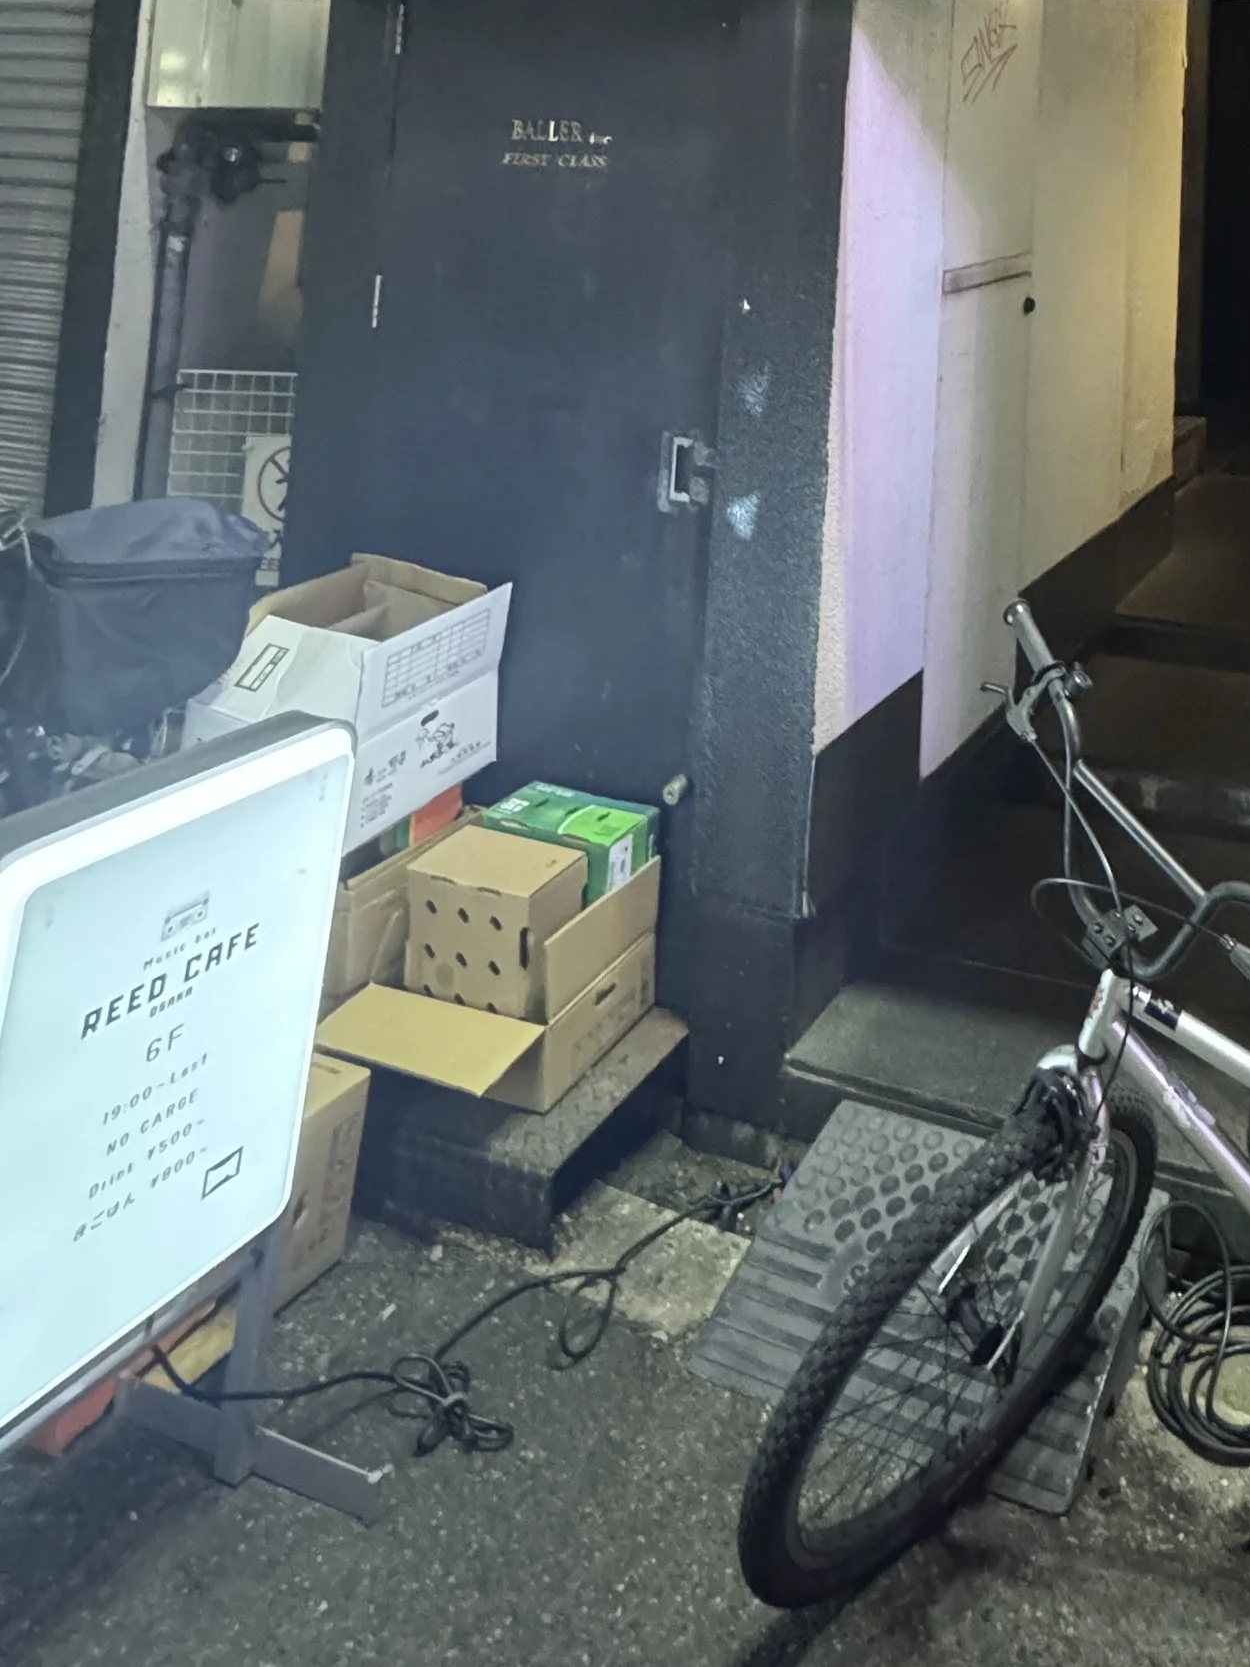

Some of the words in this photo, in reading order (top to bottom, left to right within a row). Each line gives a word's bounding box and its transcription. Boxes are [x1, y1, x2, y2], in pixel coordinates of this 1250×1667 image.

[511, 118, 584, 143] BALLER
[81, 973, 167, 1040] REED
[184, 922, 260, 983] CAFE
[149, 986, 193, 1018] OSAKA
[146, 1023, 184, 1062] 6F
[106, 1132, 130, 1157] NO
[139, 1088, 199, 1134] CARGE
